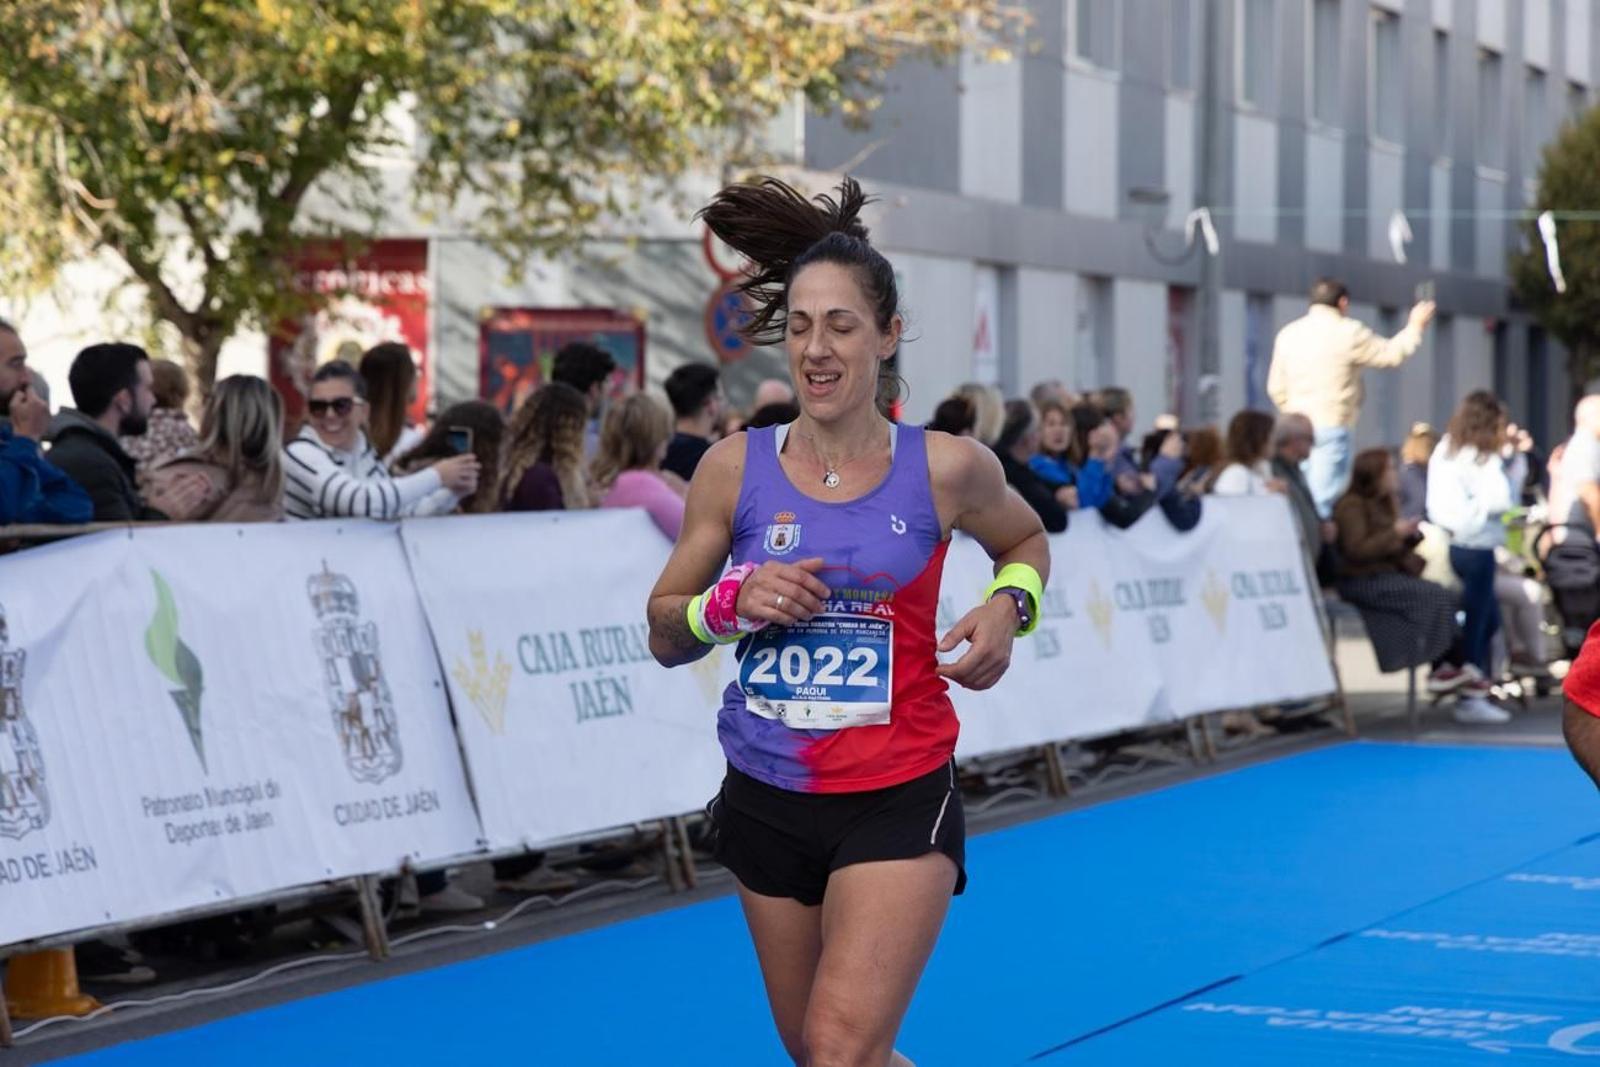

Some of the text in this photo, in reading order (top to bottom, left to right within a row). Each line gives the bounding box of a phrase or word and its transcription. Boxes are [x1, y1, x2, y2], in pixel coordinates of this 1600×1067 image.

[851, 601, 895, 616] REAL
[517, 630, 580, 675] CAJA
[748, 645, 878, 686] 2022
[569, 670, 634, 724] JAÉN
[795, 686, 827, 697] PAQUI
[382, 795, 404, 819] DE
[22, 853, 53, 880] DE
[55, 841, 98, 876] JAÉN
